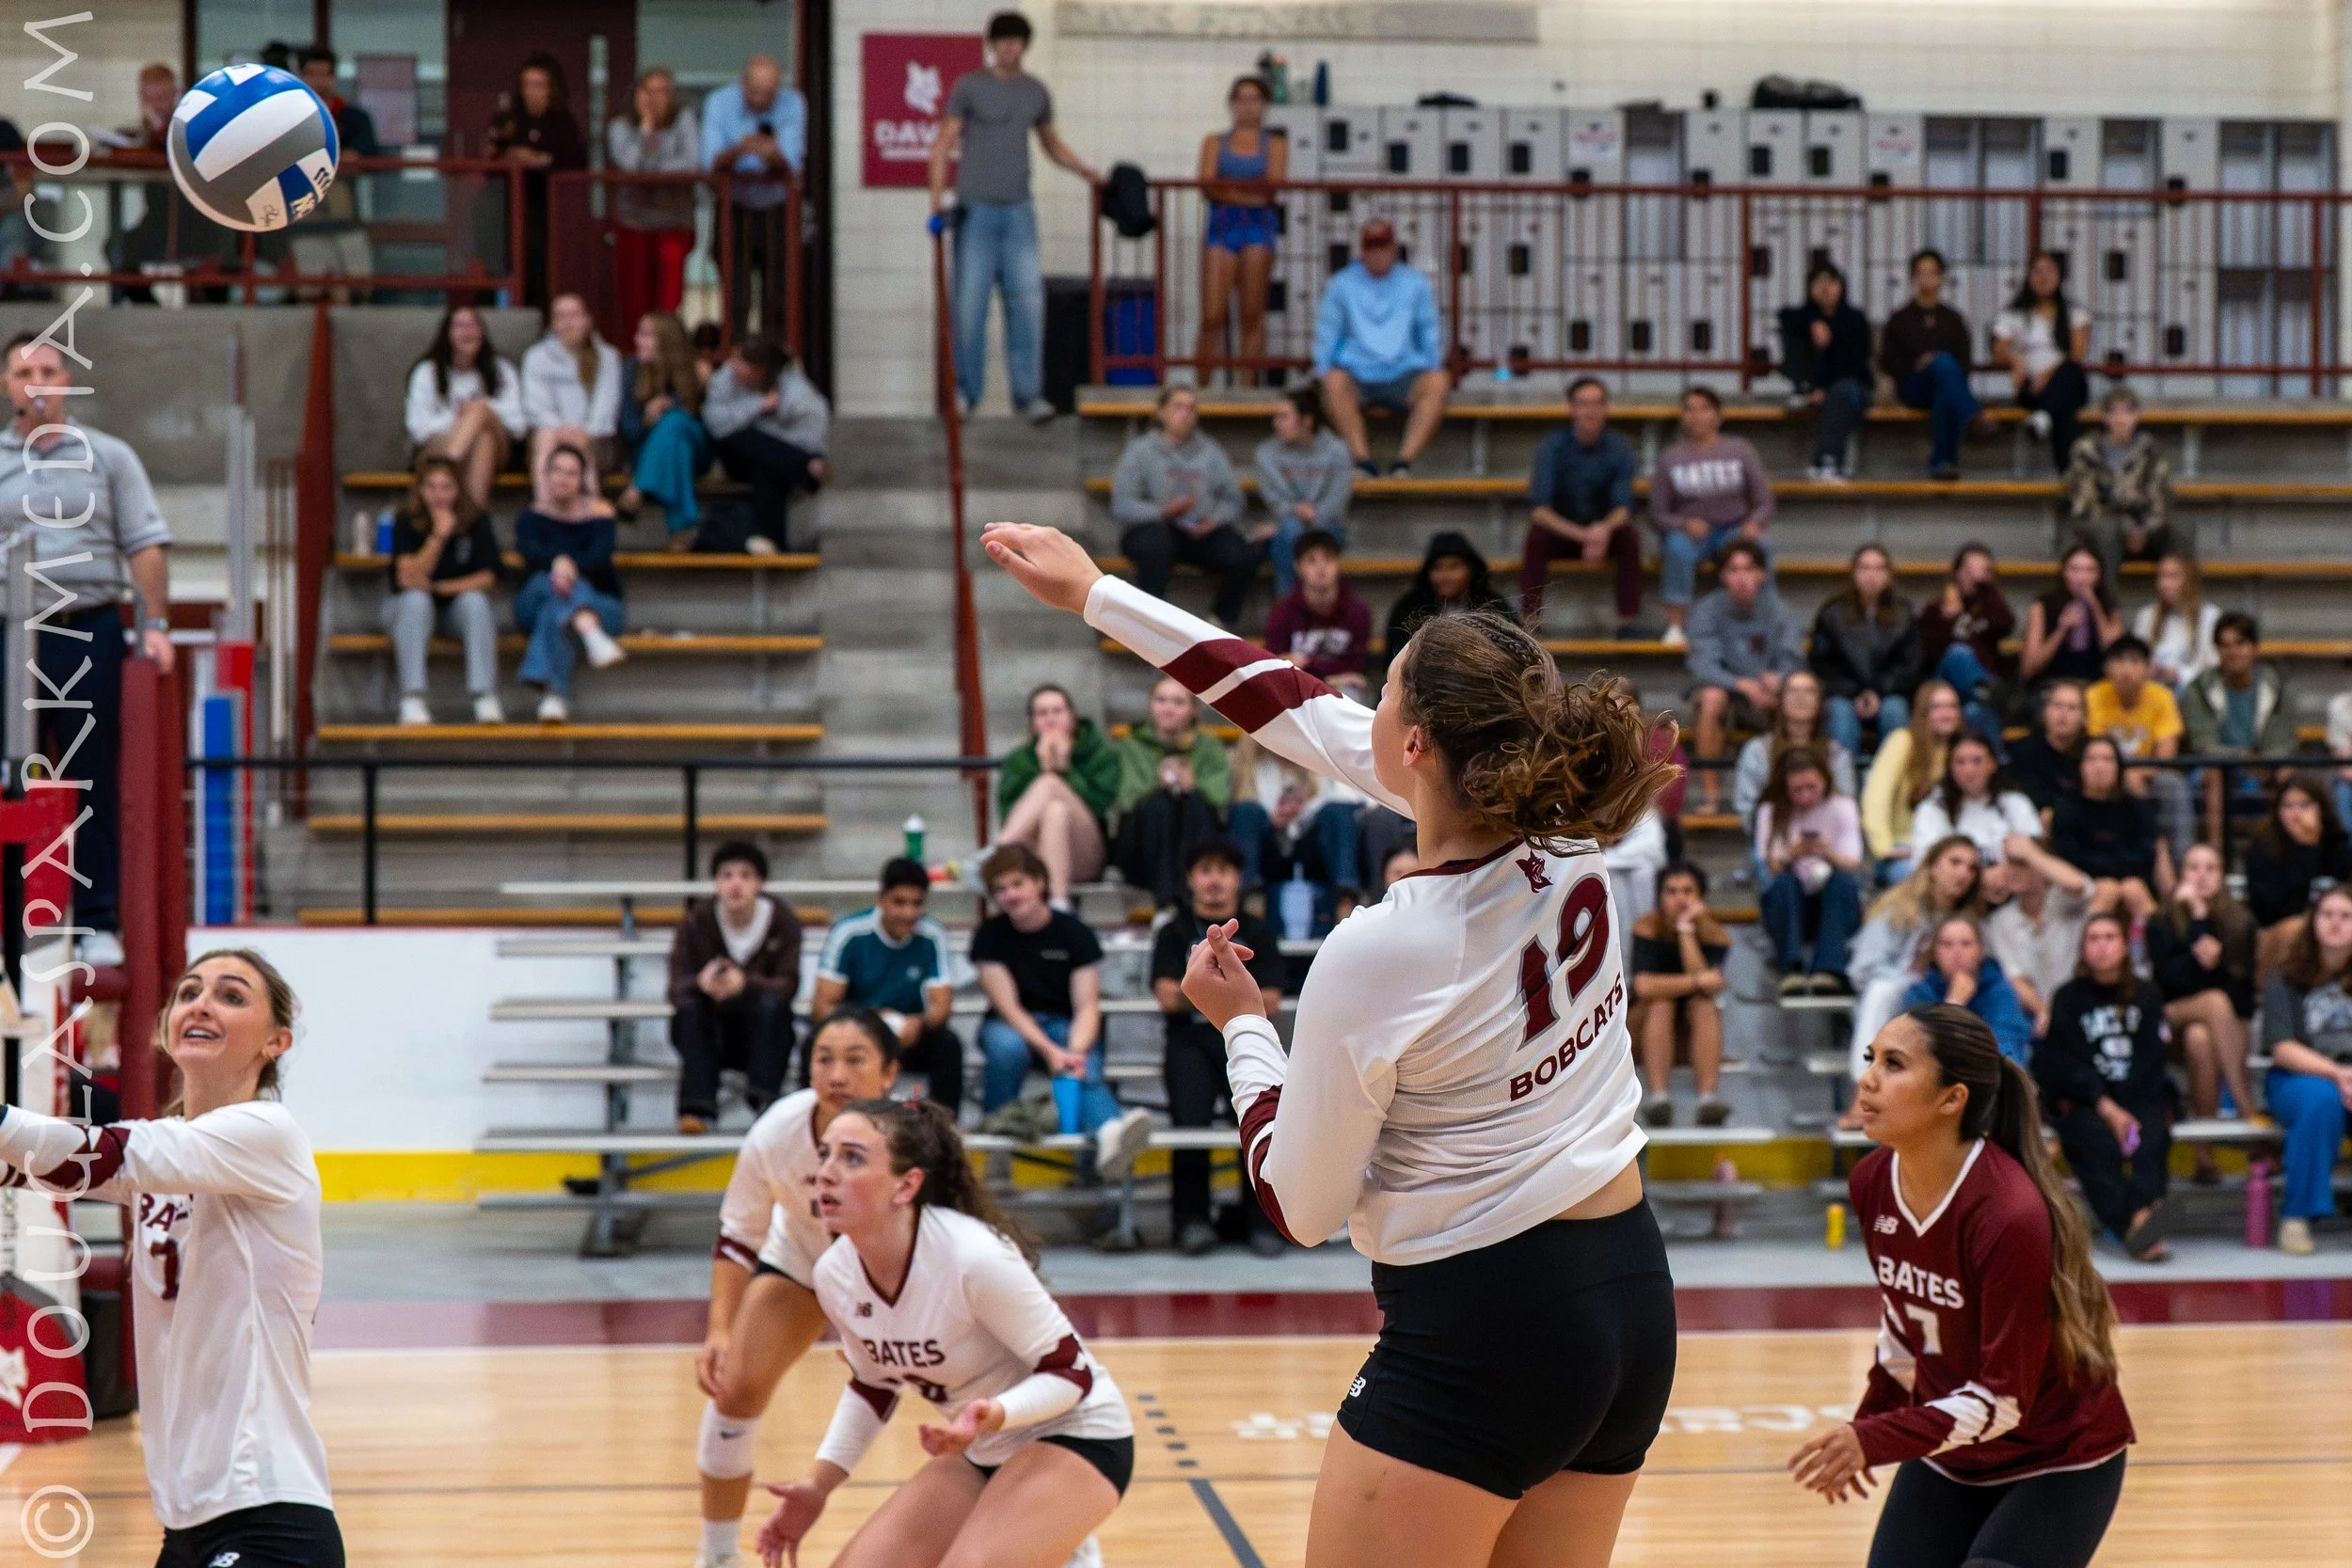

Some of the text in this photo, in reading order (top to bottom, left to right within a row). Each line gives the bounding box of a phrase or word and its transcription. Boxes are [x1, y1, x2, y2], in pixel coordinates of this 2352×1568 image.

[873, 119, 942, 145] DAV
[1516, 872, 1609, 1053] 19
[1510, 972, 1624, 1101] BOBCATS
[1878, 1255, 1965, 1310] BATES
[862, 1338, 946, 1368] BATES
